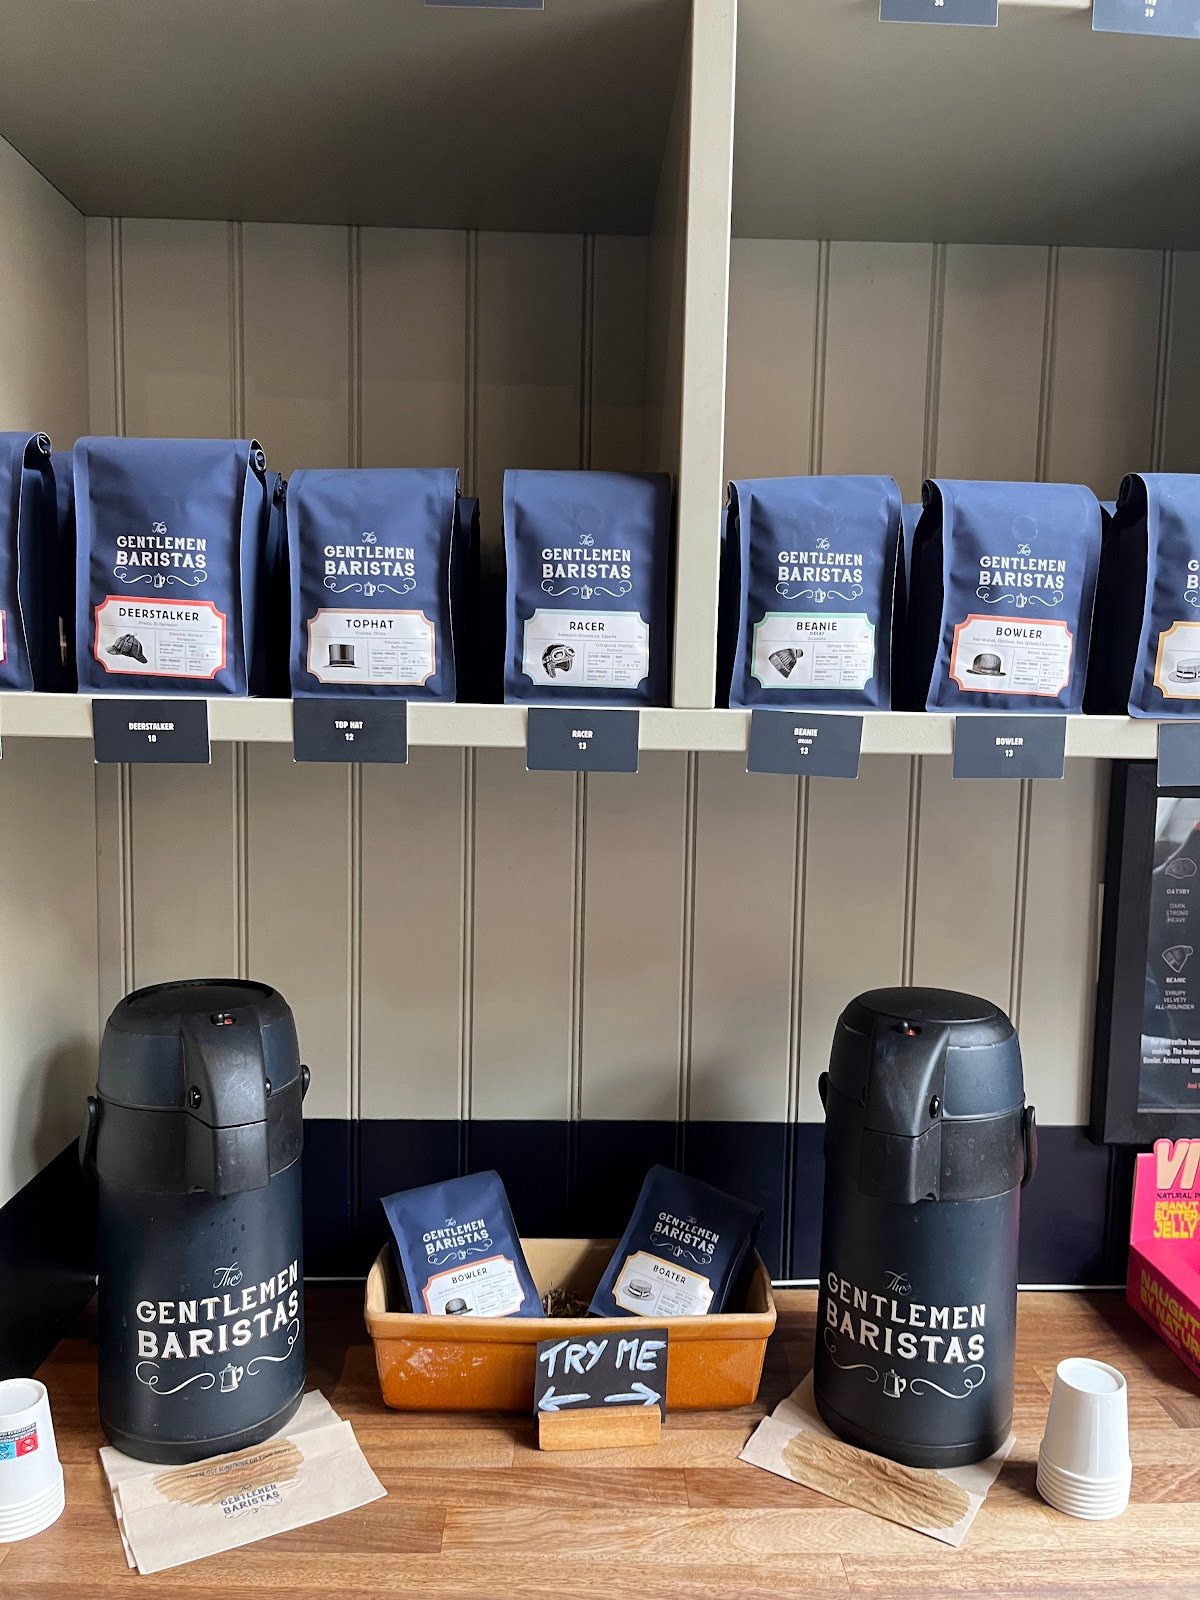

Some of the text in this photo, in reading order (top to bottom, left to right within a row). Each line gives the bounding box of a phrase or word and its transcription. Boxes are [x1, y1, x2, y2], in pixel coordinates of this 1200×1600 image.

[1144, 8, 1155, 17] 39
[116, 535, 207, 551] GENTLEMEN
[115, 550, 207, 569] BARISTAS
[323, 545, 415, 560] GENTLEMEN
[541, 548, 631, 561] GENTLEMEN
[778, 551, 863, 566] GENTLEMEN
[324, 560, 415, 577] BARISTAS
[542, 563, 631, 579] BARISTAS
[979, 556, 1066, 572] GENTLEMEN
[777, 566, 863, 583] BARISTAS
[978, 570, 1064, 589] BARISTAS
[119, 607, 199, 621] DEERSTALKER
[345, 619, 394, 629] TOPHAT
[569, 621, 605, 631] RACER
[796, 621, 837, 631] BEANIE
[996, 626, 1042, 639] BOWLER
[128, 722, 174, 731] DEERSTALKER
[334, 720, 363, 730] TOP HAT
[793, 727, 819, 737] BEANIE
[147, 734, 157, 743] 10
[344, 733, 355, 741] 12
[571, 729, 594, 739] RACER
[995, 737, 1024, 746] BOWLER
[577, 741, 587, 750] 13
[800, 746, 809, 755] 13
[1004, 749, 1014, 758] 13
[1155, 1201, 1199, 1211] PEANUT
[1154, 1210, 1199, 1221] BUTTER
[422, 1218, 486, 1243] GENTLEMEN
[658, 1211, 720, 1244] GENTLEMEN
[1153, 1220, 1197, 1239] JELLY
[425, 1229, 490, 1255] BARISTAS
[653, 1221, 716, 1255] BARISTAS
[212, 1261, 243, 1289] The
[451, 1267, 488, 1284] BOWLER
[652, 1264, 686, 1285] BOATER
[883, 1270, 913, 1297] The
[136, 1259, 298, 1325] GENTLEMEN
[826, 1271, 986, 1330] GENTLEMEN
[137, 1289, 299, 1360] BARISTAS
[825, 1297, 985, 1364] BARISTAS
[1155, 1301, 1200, 1360] NATUR
[539, 1338, 667, 1378] TRY ME
[220, 1483, 278, 1507] GENTLEMEN
[223, 1491, 280, 1515] BARISTAS
